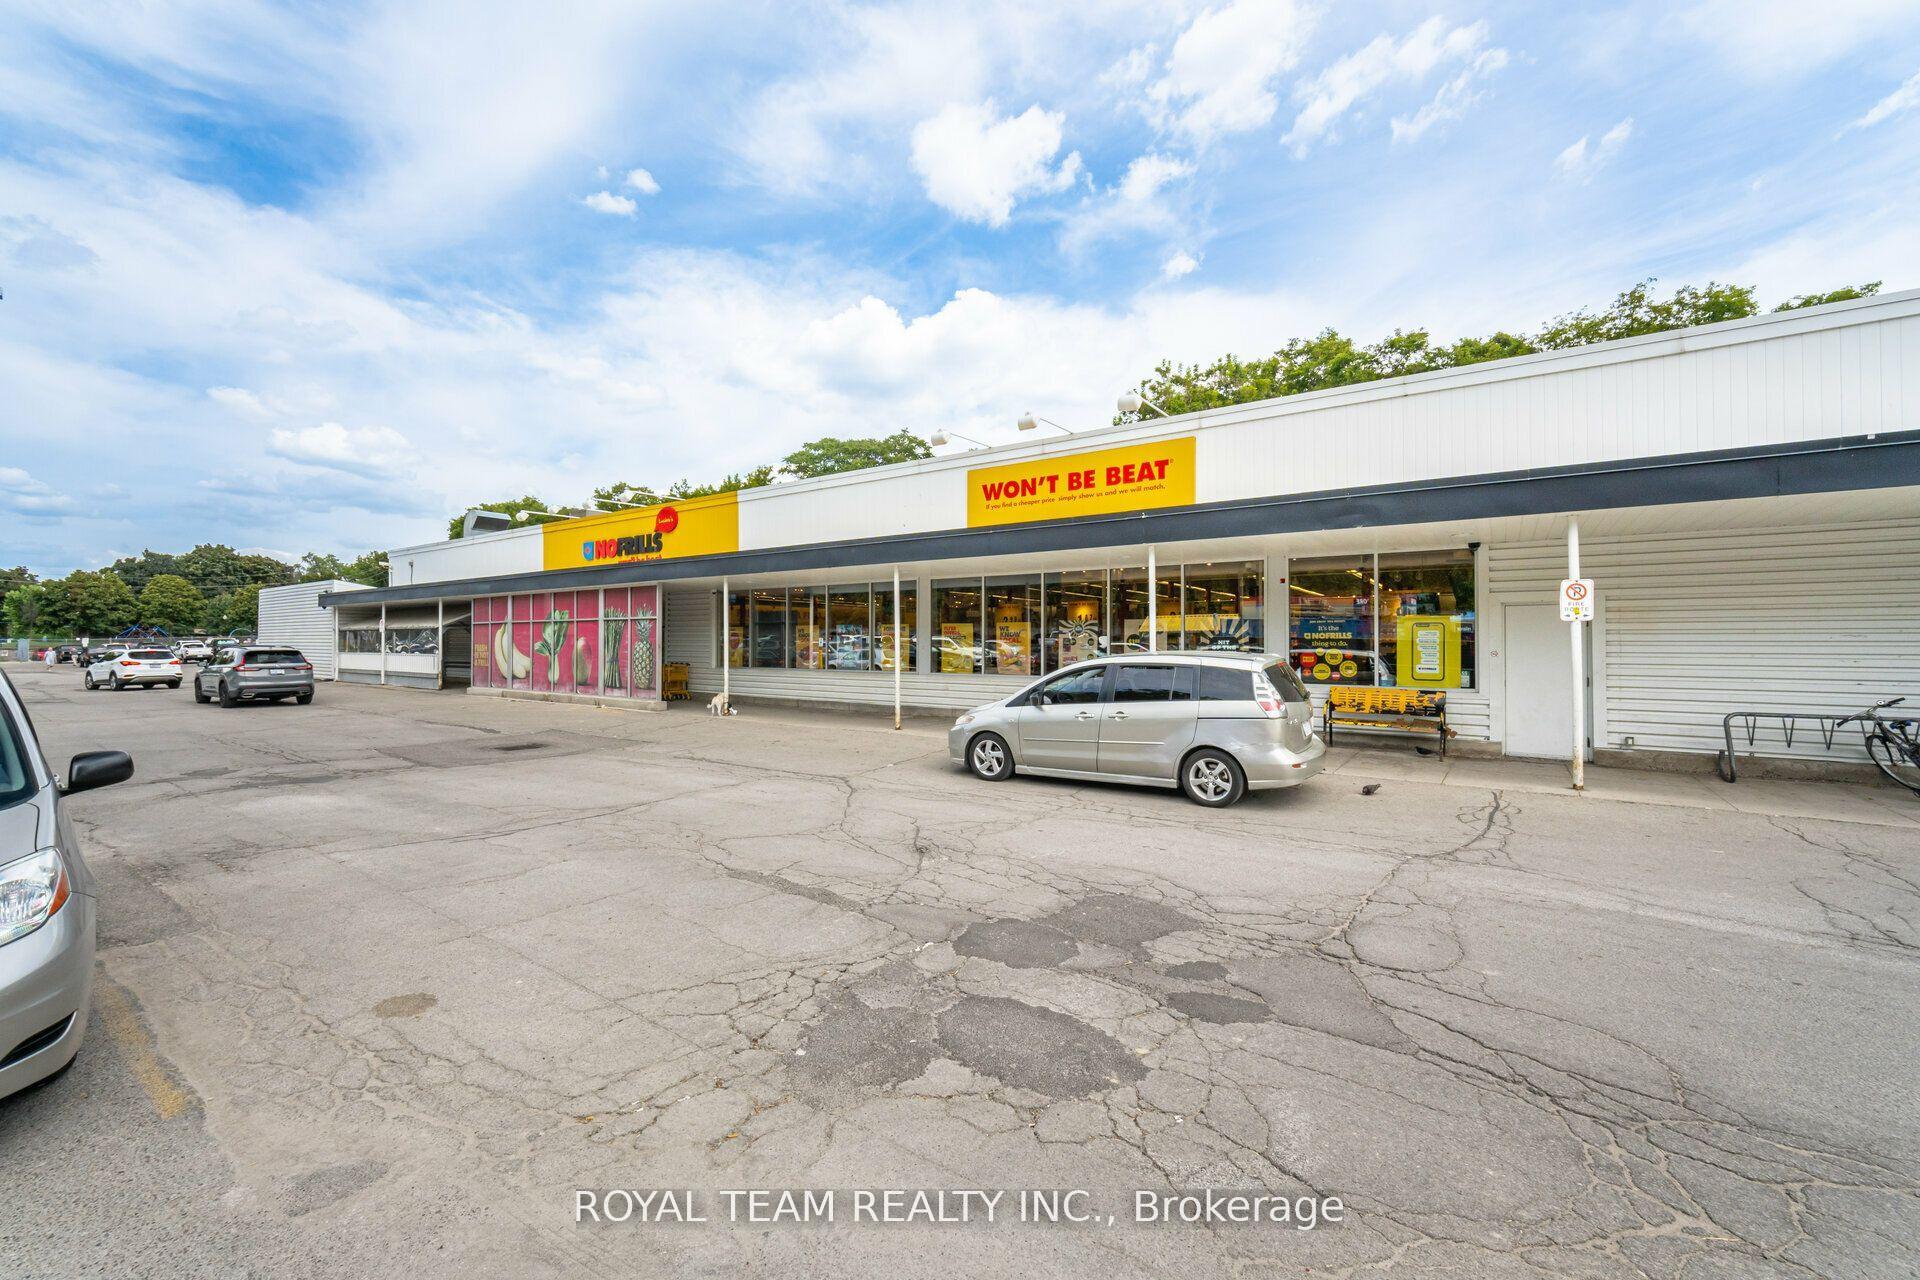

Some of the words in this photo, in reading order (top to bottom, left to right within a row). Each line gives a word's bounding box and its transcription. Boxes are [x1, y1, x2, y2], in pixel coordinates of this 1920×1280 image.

[982, 475, 1059, 501] WON'T
[1067, 470, 1096, 491] BE
[1106, 459, 1169, 486] BEAT
[1058, 494, 1077, 502] simply
